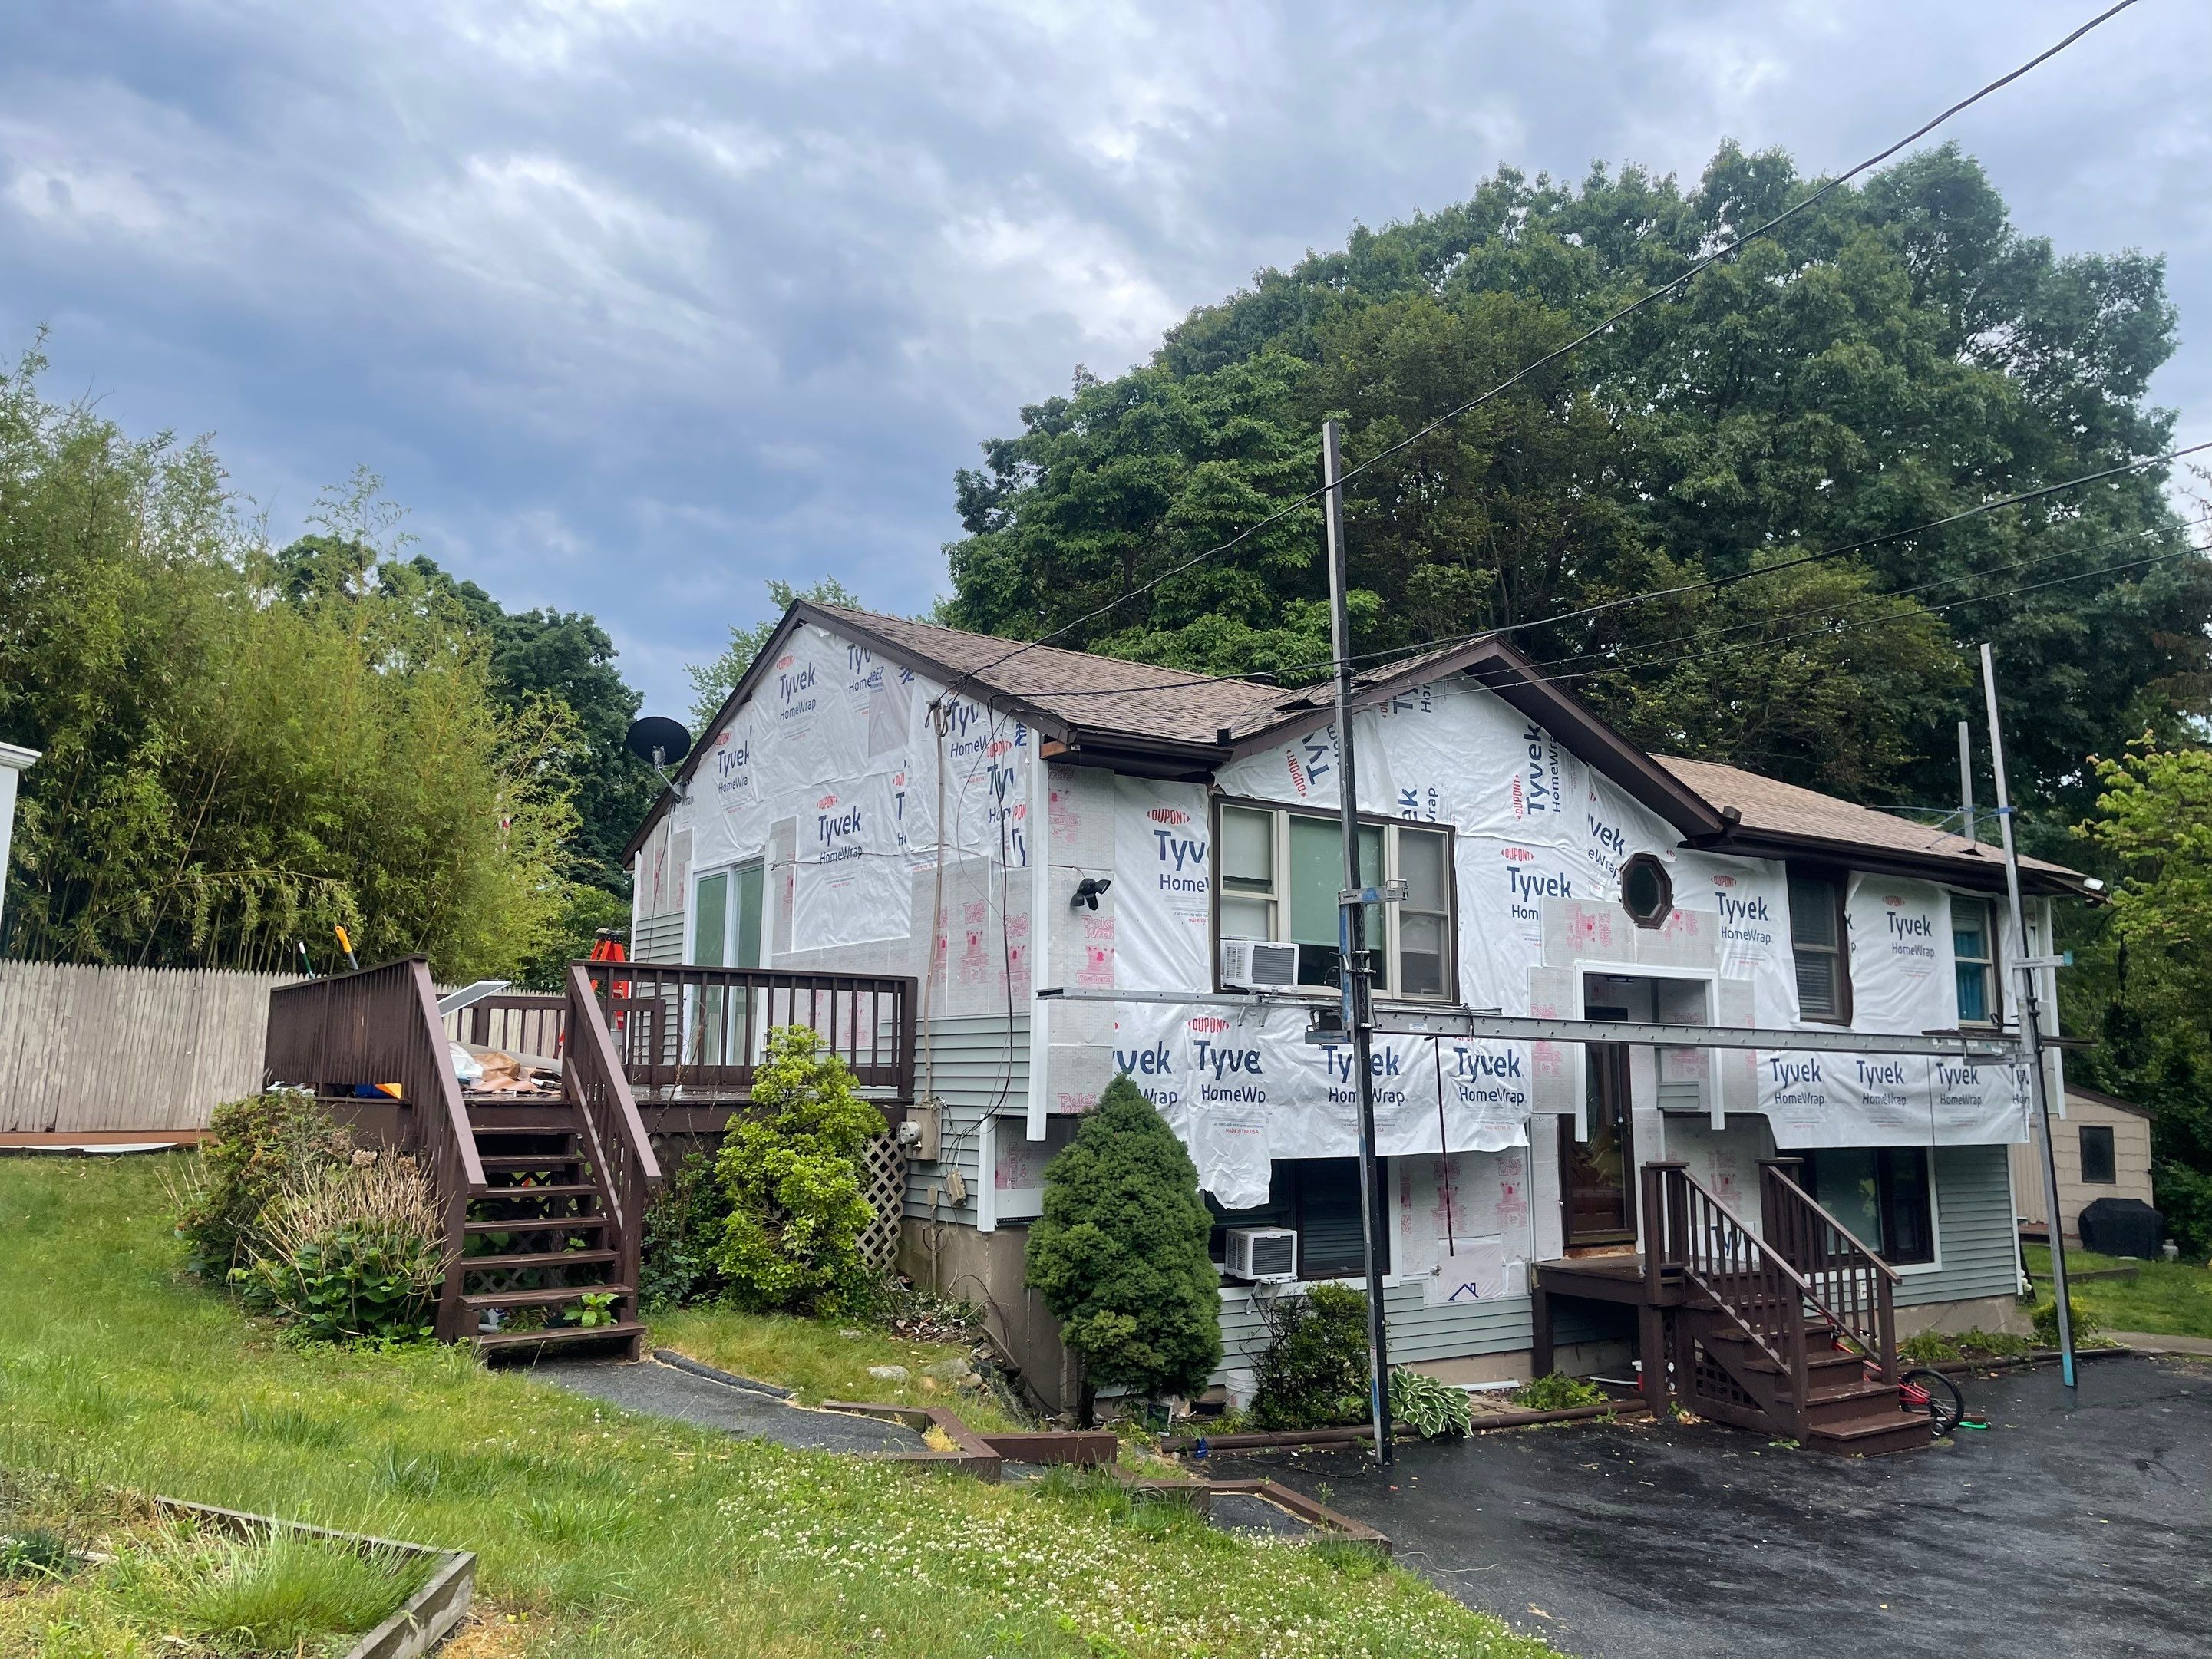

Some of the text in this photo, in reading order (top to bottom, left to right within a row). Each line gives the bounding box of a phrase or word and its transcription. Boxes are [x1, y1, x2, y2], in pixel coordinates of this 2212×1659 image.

[780, 662, 816, 704] Tyvek
[780, 698, 816, 721] HomeWrap
[1287, 753, 1306, 793] DUPONT
[1524, 724, 1550, 815] Tyvek
[1513, 779, 1523, 815] DUPONT
[818, 806, 861, 847] Tyvek
[1151, 808, 1187, 825] DUPONT
[820, 845, 863, 865] HomeWrap
[1154, 830, 1206, 872] Tyv
[1505, 848, 1530, 862] DUPONT
[1160, 874, 1209, 892] Home
[1507, 866, 1572, 902] Tyvek
[1512, 905, 1540, 920] Hom
[1715, 892, 1768, 924] Tyvek
[1722, 926, 1771, 945] HomeWrap
[1887, 912, 1932, 940] Tyvek
[1892, 942, 1935, 959] HomeWrap
[1193, 1017, 1227, 1033] DUPONT
[1113, 1041, 1172, 1074] vek
[1323, 1045, 1401, 1084] Tyek
[1453, 1047, 1521, 1084] Tyvek
[1770, 1058, 1822, 1089] Tyvek
[1856, 1060, 1904, 1090] Tyvek
[1936, 1063, 1979, 1091] Tyvek
[1459, 1087, 1525, 1107] HomeWrap
[1775, 1092, 1824, 1106] HomeWrap
[1863, 1093, 1907, 1106] HomeWrap
[1940, 1093, 1982, 1107] HomeWrap
